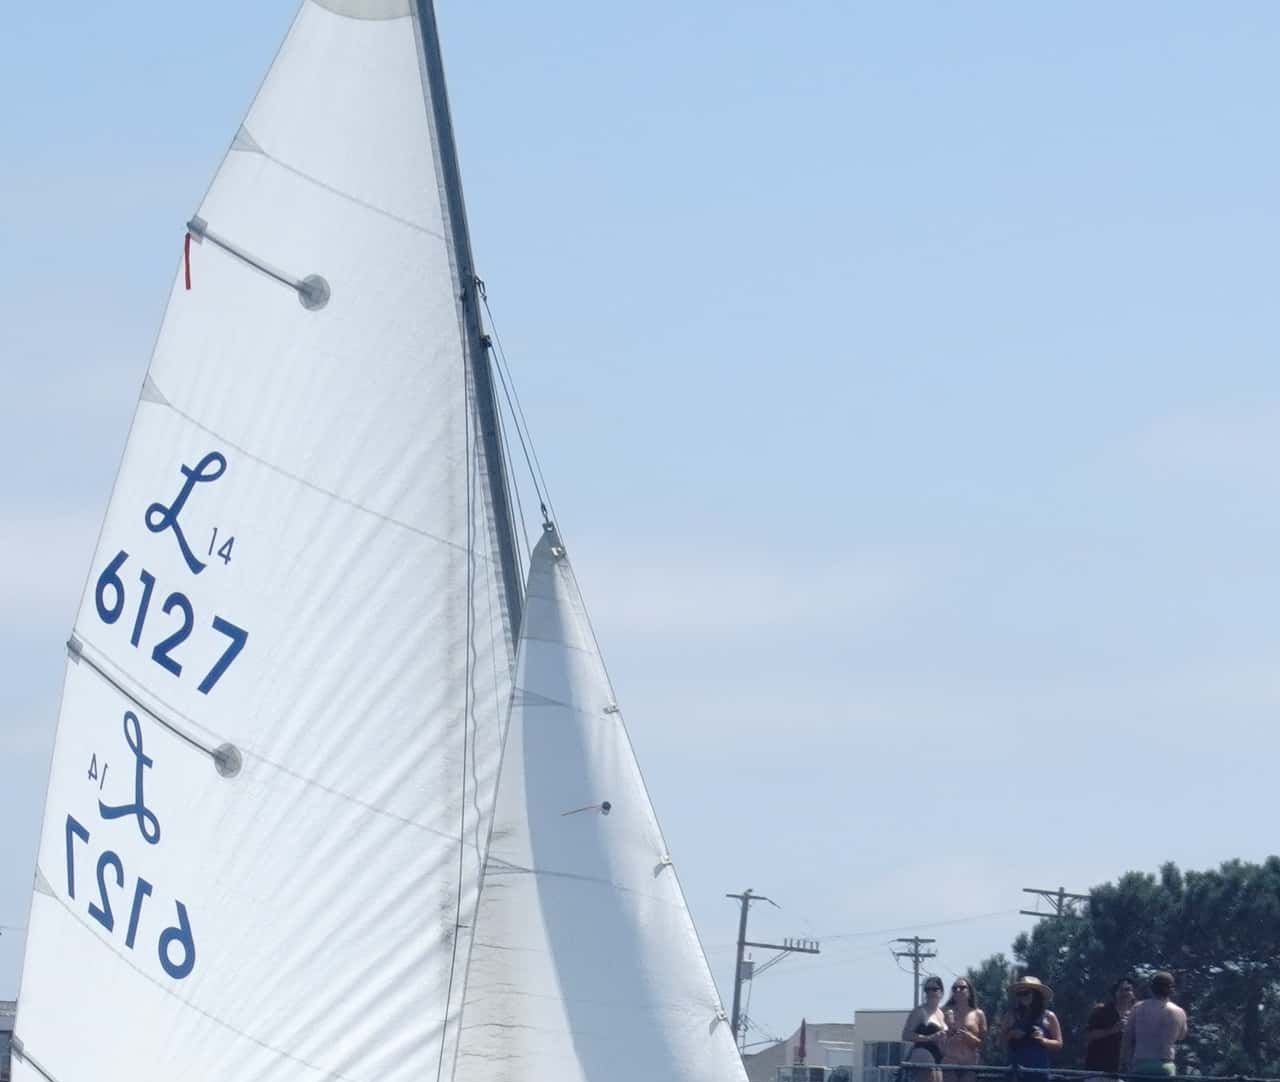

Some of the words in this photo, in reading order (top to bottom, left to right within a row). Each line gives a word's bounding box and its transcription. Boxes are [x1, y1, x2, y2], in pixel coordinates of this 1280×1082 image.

[145, 451, 228, 575] L
[206, 527, 236, 566] 14
[94, 549, 249, 695] 6127
